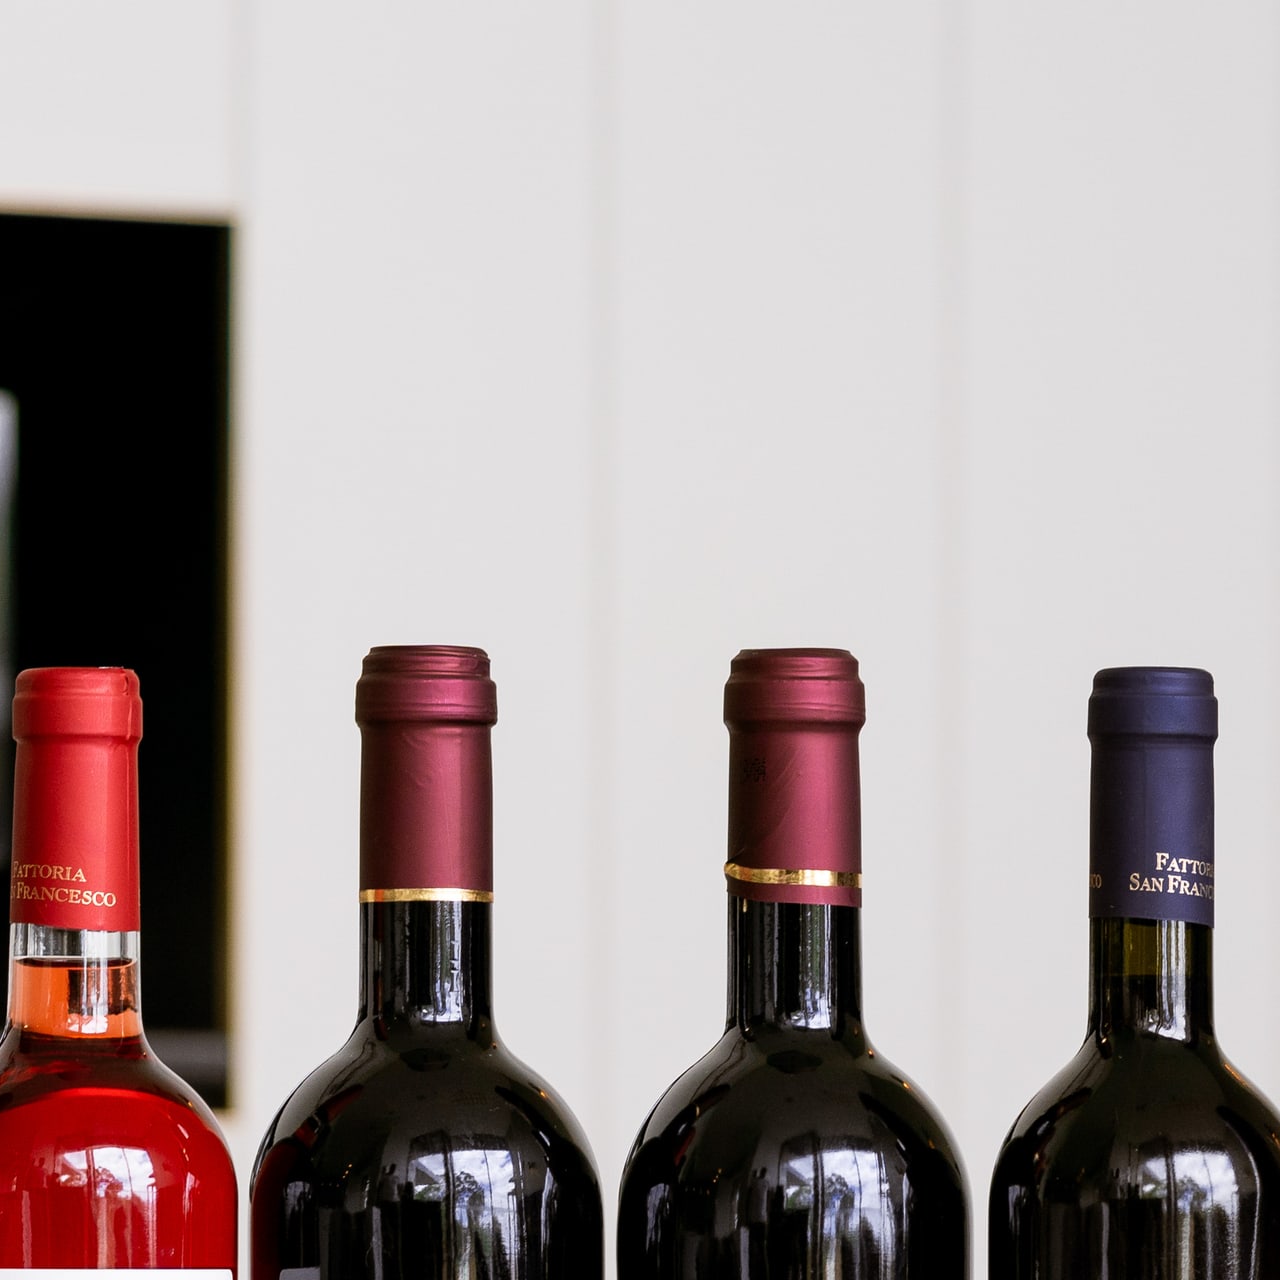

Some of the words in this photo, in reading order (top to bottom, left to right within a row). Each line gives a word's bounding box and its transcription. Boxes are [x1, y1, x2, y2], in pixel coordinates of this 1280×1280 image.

[12, 861, 87, 882] FATTORIA
[1155, 852, 1213, 878] FATTOR
[17, 882, 116, 907] FRANCESCO
[1129, 873, 1164, 893] SAN
[1167, 875, 1214, 900] FRANC
